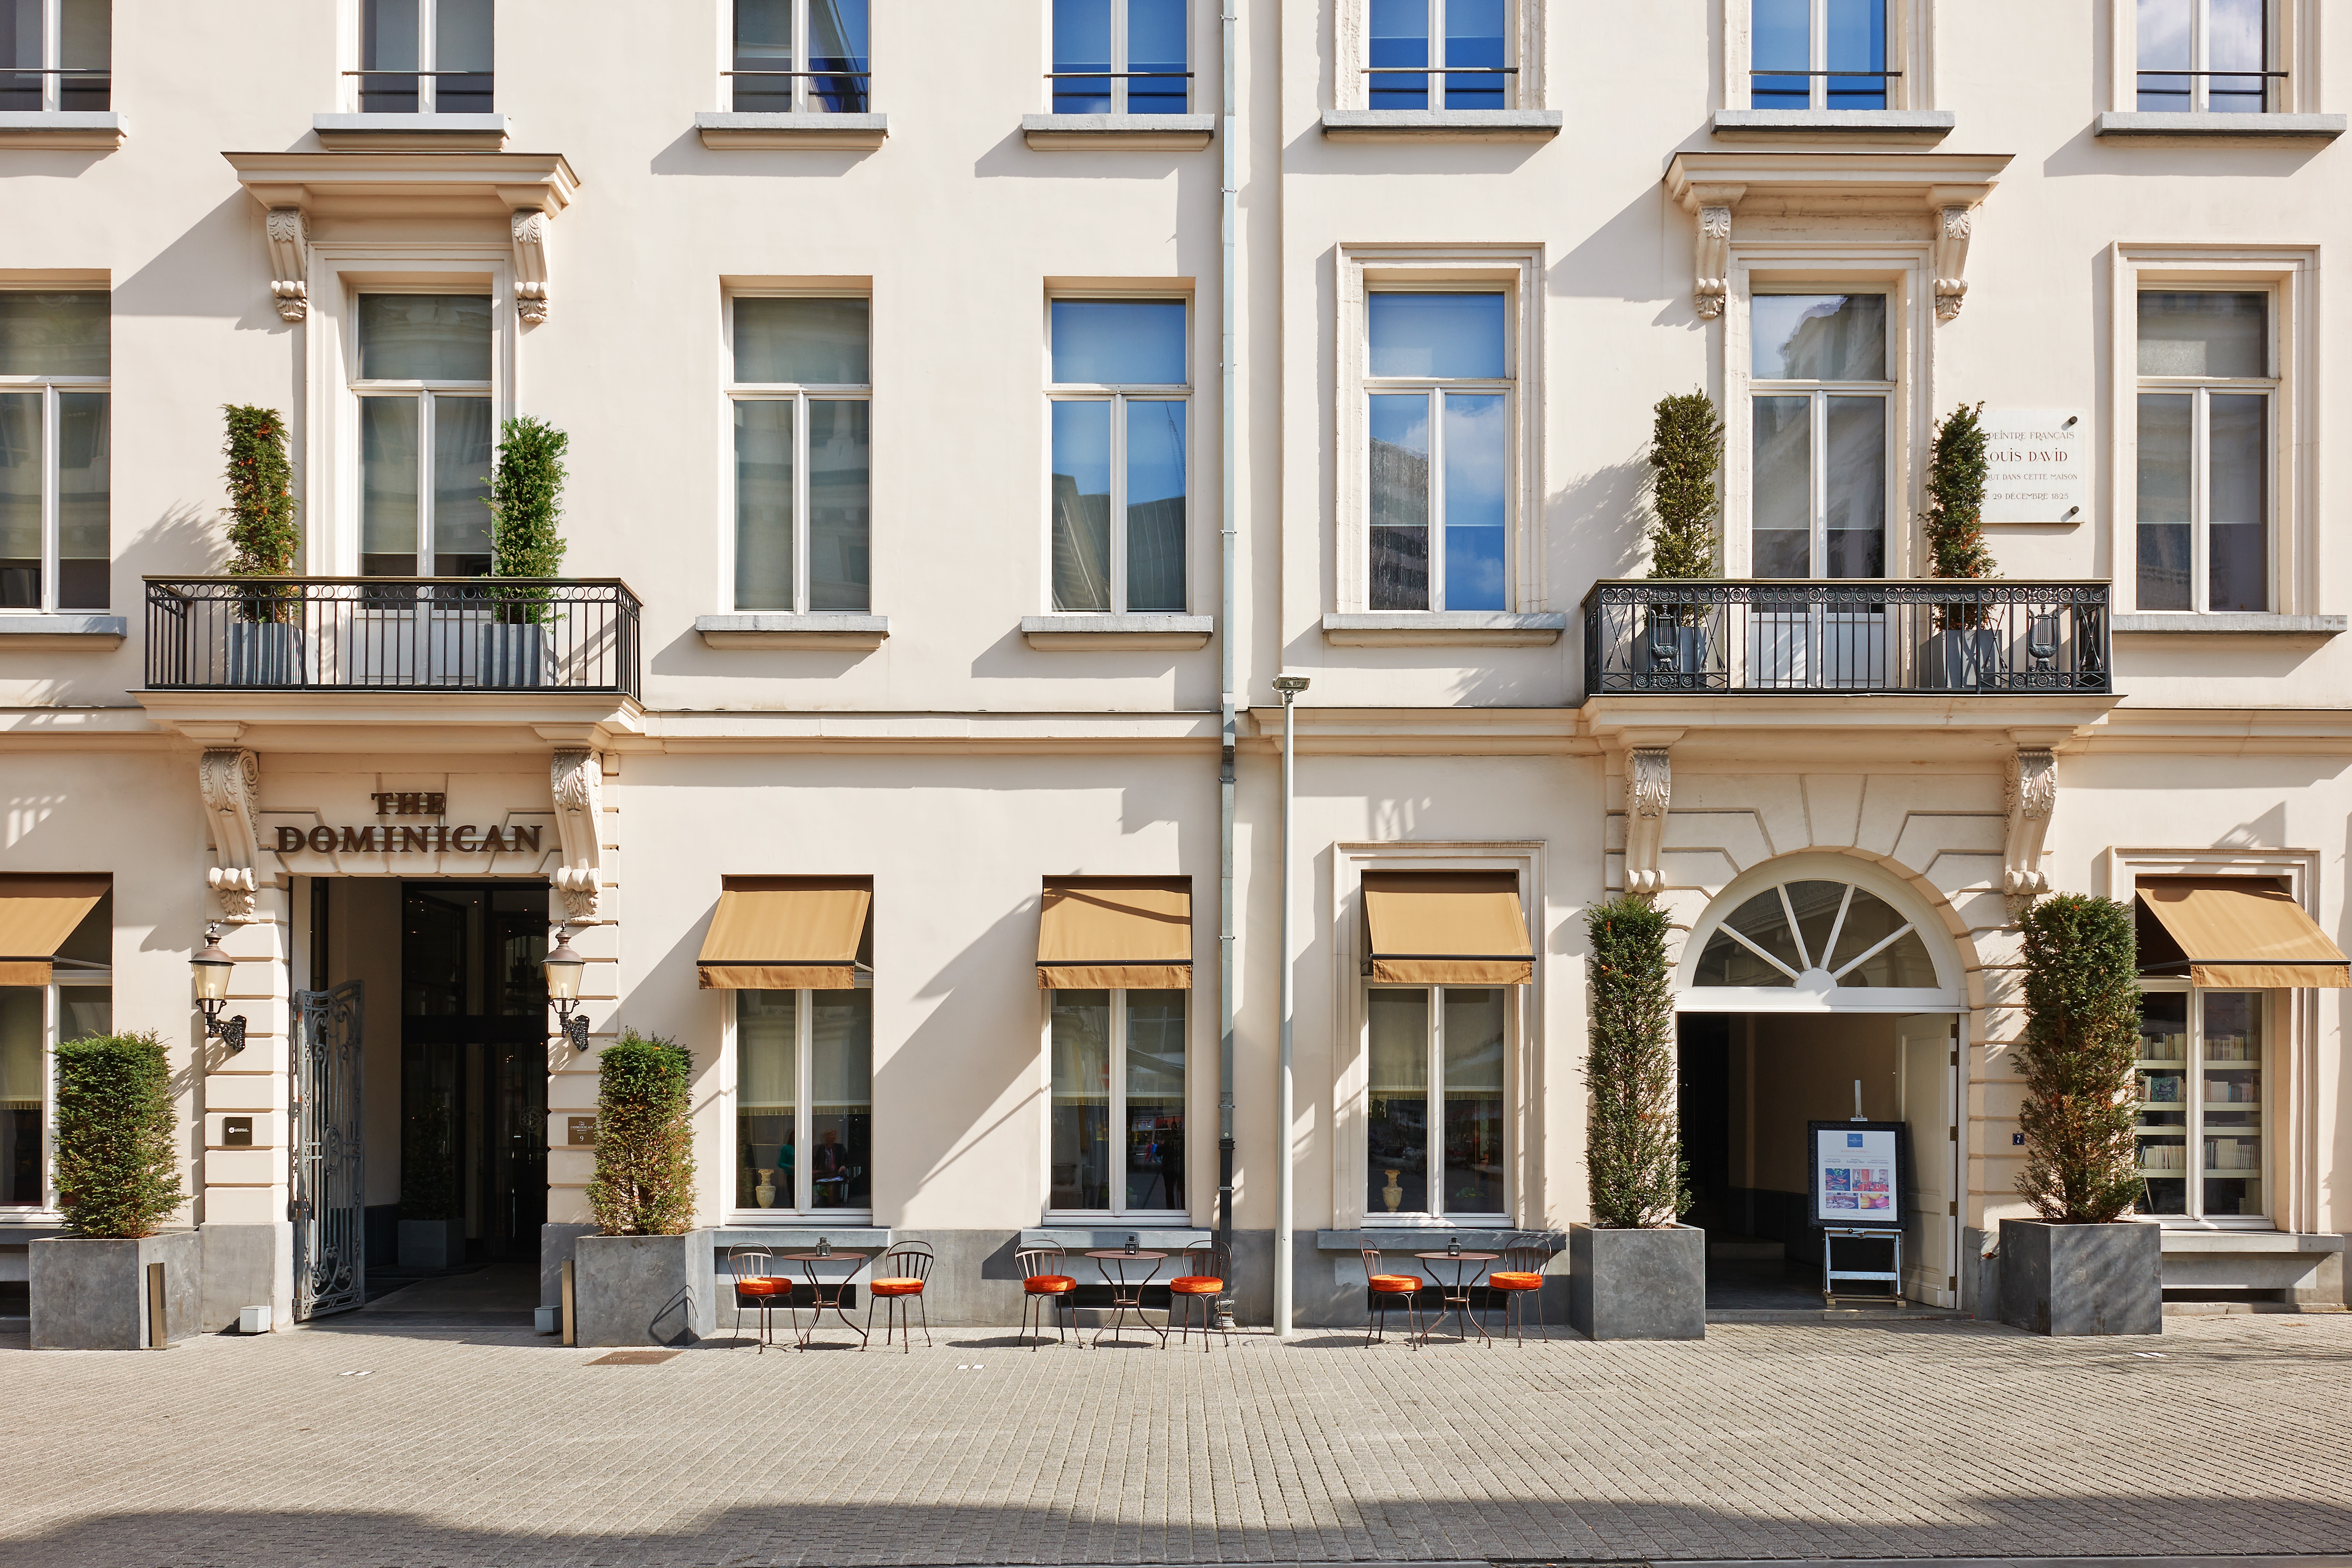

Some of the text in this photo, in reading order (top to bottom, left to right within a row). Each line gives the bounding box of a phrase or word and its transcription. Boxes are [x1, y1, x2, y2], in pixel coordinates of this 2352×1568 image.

[1989, 430, 2074, 441] PEINTRE FRANÇAIS
[2029, 448, 2067, 462] DAVID
[2005, 492, 2048, 500] DÉCEMBRE
[371, 792, 445, 815] THE
[275, 824, 543, 853] DOMINICAN
[2017, 1135, 2021, 1143] 7
